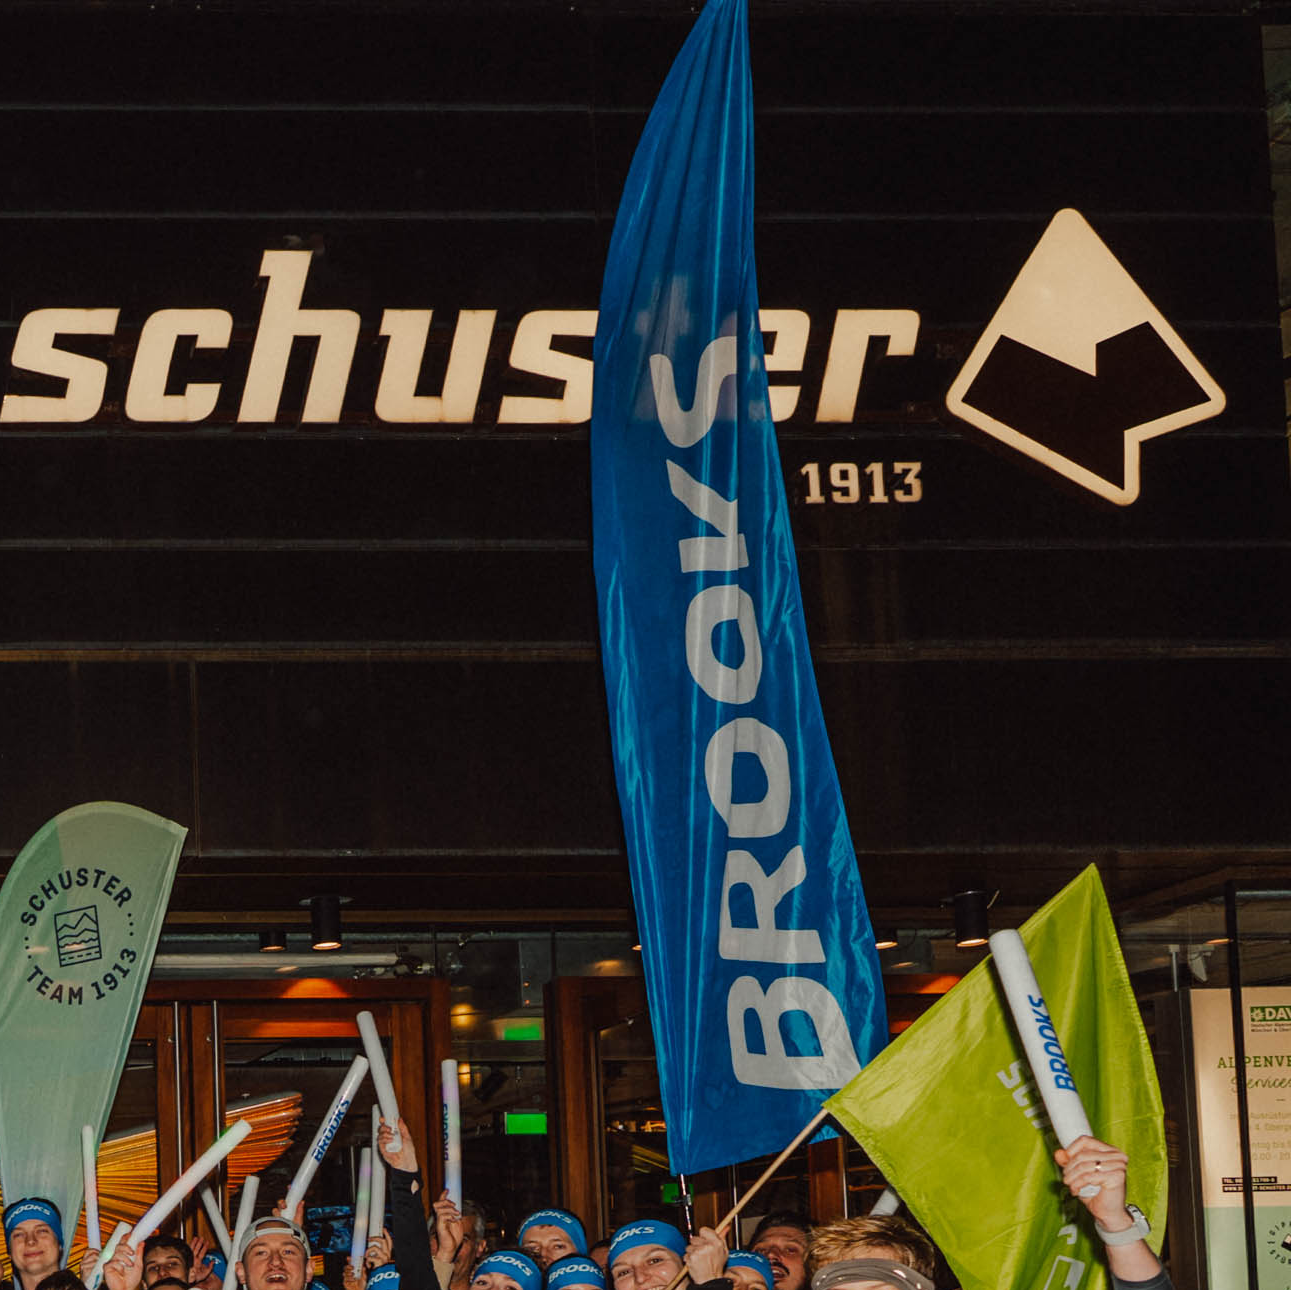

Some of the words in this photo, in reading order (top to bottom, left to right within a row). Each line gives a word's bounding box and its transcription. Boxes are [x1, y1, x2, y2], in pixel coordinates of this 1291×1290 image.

[0, 250, 921, 424] schuser
[801, 461, 923, 504] 1913
[650, 336, 861, 1090] BROOKS
[21, 868, 132, 927] SCHUSTER
[27, 965, 83, 1005] TEAM
[91, 948, 137, 1000] 1913
